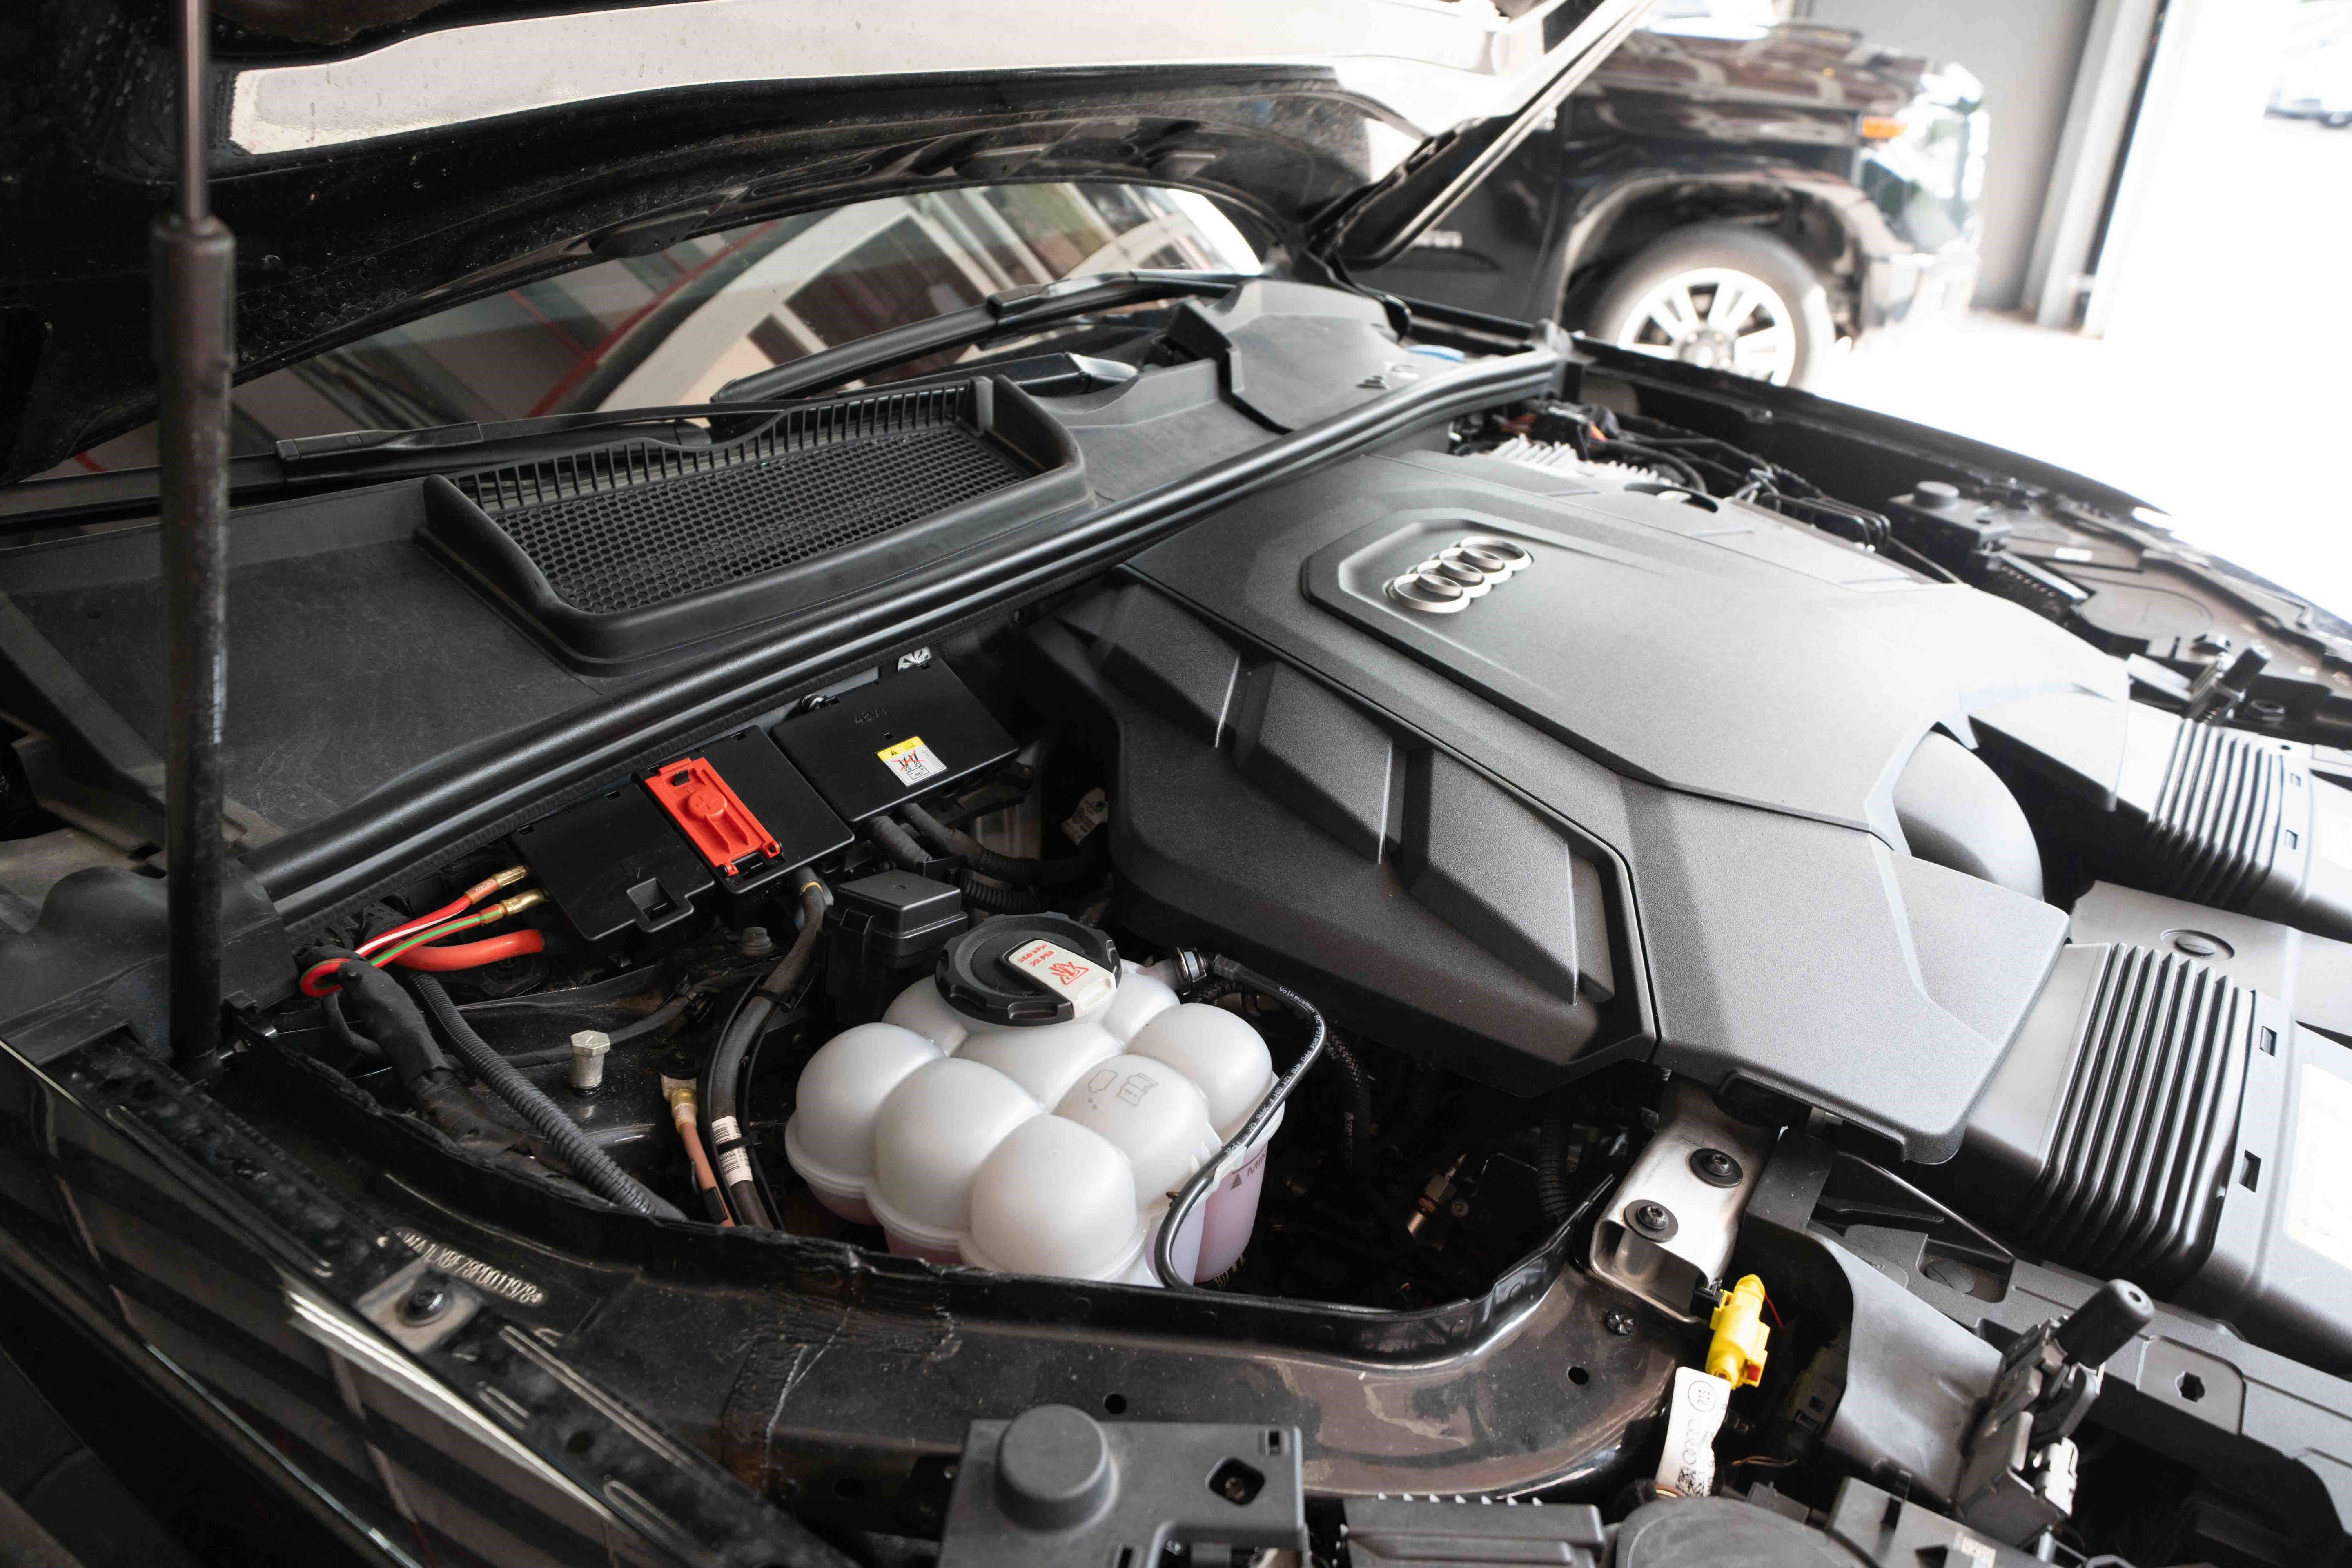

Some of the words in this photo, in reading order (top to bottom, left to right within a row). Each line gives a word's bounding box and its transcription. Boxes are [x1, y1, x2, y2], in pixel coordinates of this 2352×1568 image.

[1279, 986, 1315, 1013] Volkswagen
[1314, 1014, 1322, 1023] AG
[1310, 1026, 1323, 1049] Poland
[1281, 1075, 1291, 1085] 121
[1247, 1147, 1266, 1176] MIN
